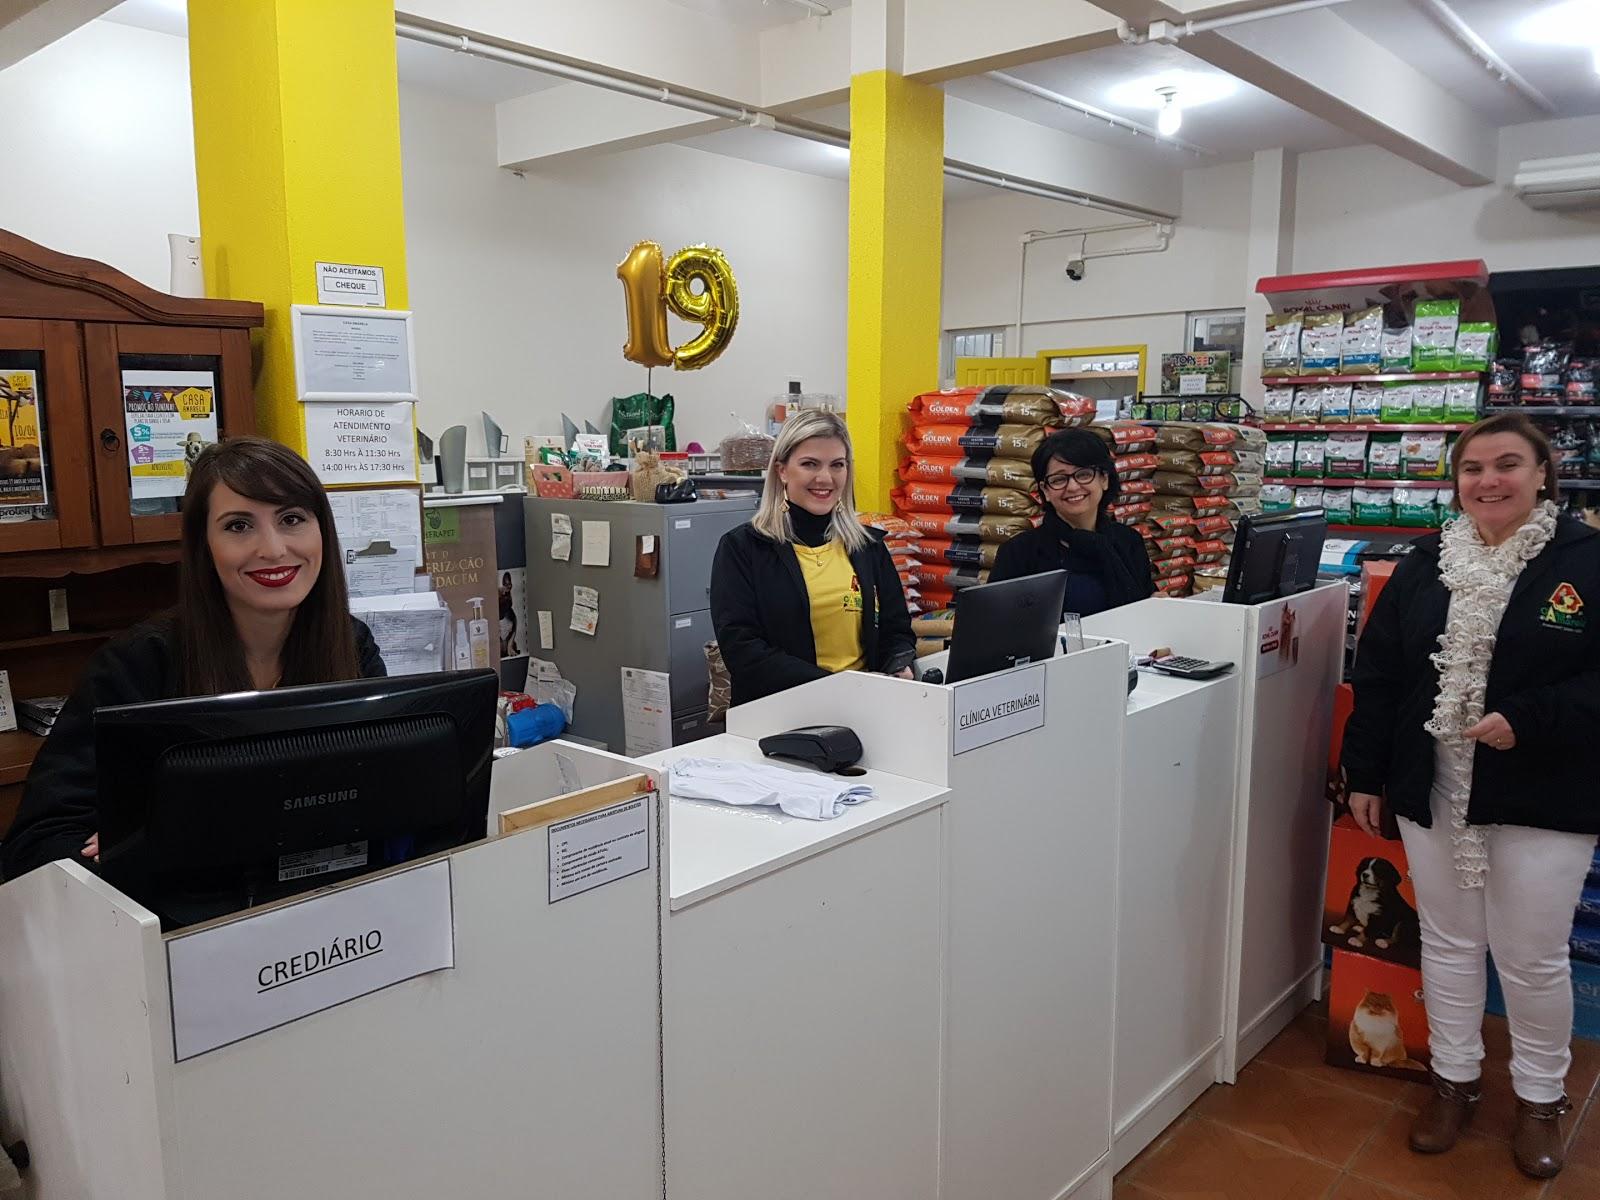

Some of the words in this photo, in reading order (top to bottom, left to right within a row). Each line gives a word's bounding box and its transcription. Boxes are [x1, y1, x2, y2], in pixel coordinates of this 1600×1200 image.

[339, 268, 376, 276] ACEITAMOS
[336, 281, 366, 290] CHEQUE
[616, 240, 739, 370] 19
[182, 394, 204, 406] CASA
[929, 405, 960, 413] GOLDEN
[375, 410, 386, 418] DE
[334, 422, 390, 431] ATENDIMENTO
[337, 434, 388, 443] VETERINÁRIO
[923, 434, 951, 442] GOLDEN
[366, 450, 386, 458] 11:30
[388, 450, 400, 458] Hrs
[322, 464, 342, 472] 14:00
[344, 464, 358, 472] Hrs
[371, 464, 390, 472] 17:30
[392, 464, 405, 472] Hrs
[917, 463, 944, 472] GOLDEN
[912, 493, 938, 502] GOLDEN
[911, 520, 937, 529] GOLDEN
[960, 708, 990, 726] CLÍNICA
[992, 694, 1040, 716] VETERINÁRIA
[284, 789, 358, 810] SAMSUNG
[258, 930, 382, 986] CREDIÁRIO
